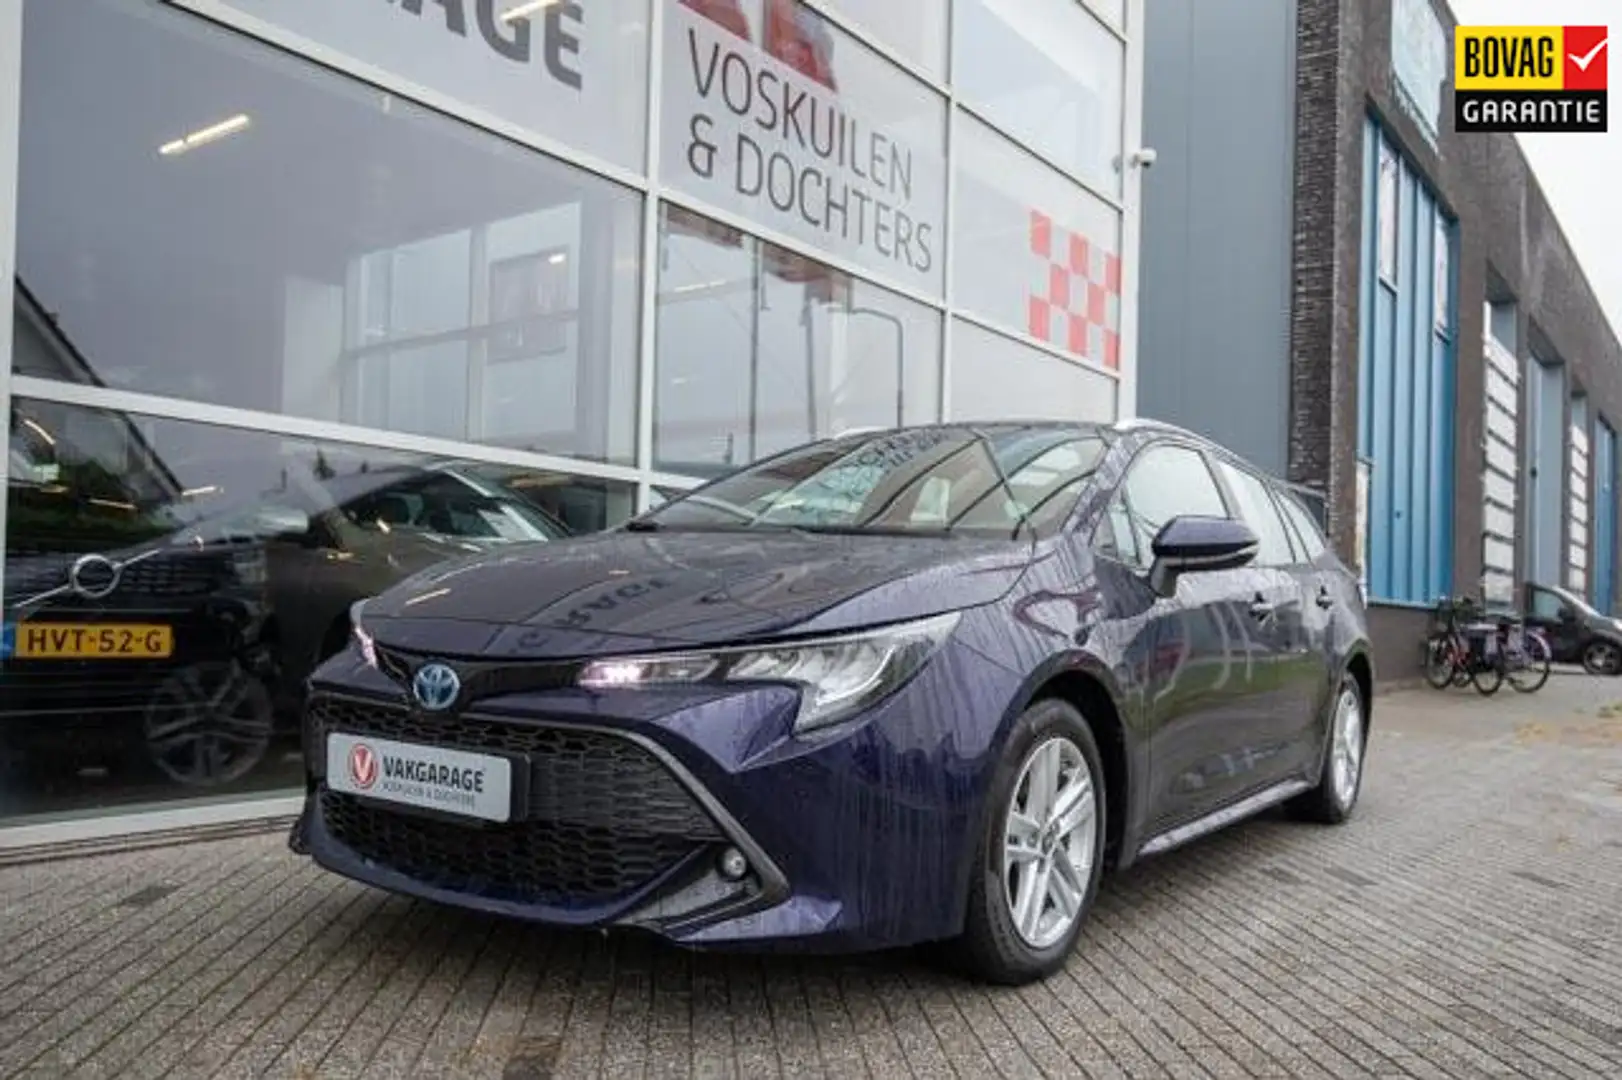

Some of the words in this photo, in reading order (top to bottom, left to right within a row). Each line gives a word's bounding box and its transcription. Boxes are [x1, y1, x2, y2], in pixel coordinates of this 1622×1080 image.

[688, 28, 912, 200] VOSKUILEN
[687, 114, 718, 180] &
[736, 134, 931, 274] DOCHTERS
[27, 628, 162, 653] HVT-52-G
[383, 755, 484, 793] VAKGARAGE
